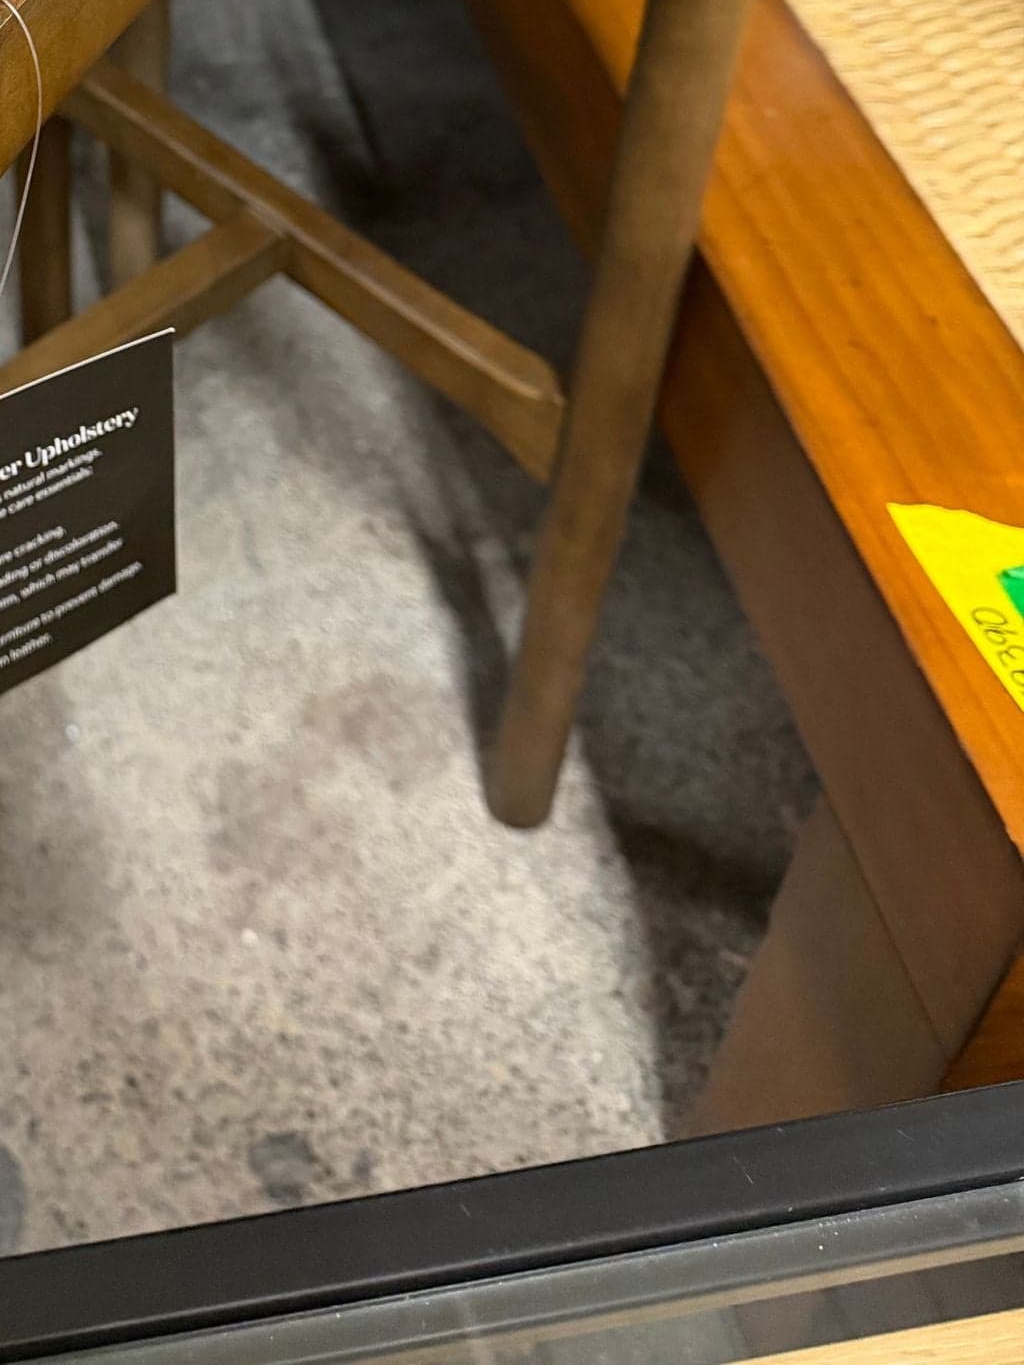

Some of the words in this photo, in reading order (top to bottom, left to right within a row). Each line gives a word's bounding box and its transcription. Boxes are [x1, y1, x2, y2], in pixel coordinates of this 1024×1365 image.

[23, 406, 139, 468] Upholstery
[2, 470, 46, 500] natural
[45, 447, 102, 480] markings.
[6, 493, 35, 514] care
[28, 557, 43, 572] or
